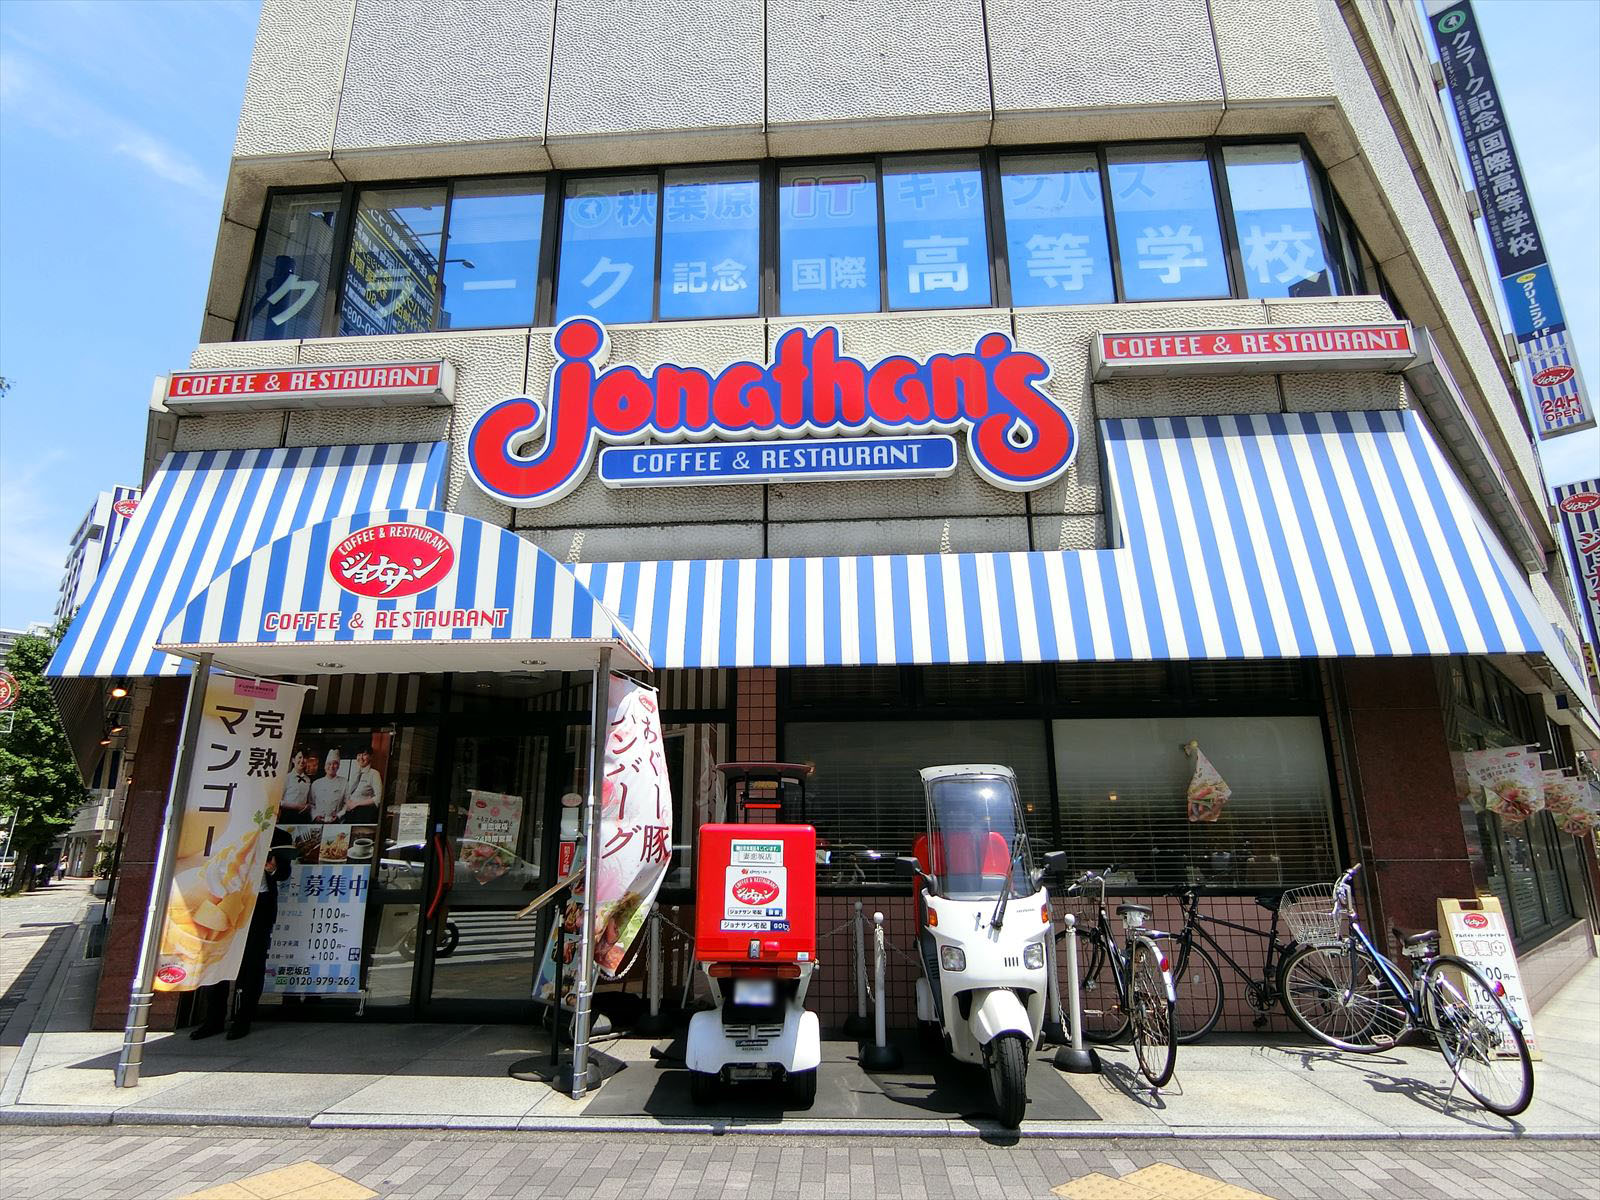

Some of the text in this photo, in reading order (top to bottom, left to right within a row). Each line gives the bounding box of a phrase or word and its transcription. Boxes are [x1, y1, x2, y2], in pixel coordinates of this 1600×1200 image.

[1451, 29, 1539, 258] クラーク記念国際高等学校
[265, 224, 1321, 326] クラーク記念国際高等学校
[1112, 330, 1401, 358] COFFEE & RESTAURANT
[1532, 327, 1550, 339] 1F
[177, 365, 437, 395] COFFEE & RESTAURANT
[1541, 393, 1580, 414] 24H
[1545, 406, 1582, 422] OPEN
[632, 443, 922, 475] COFFEE & RESTAURANT
[338, 525, 450, 556] COFFEE & RESTAURANT
[340, 552, 442, 596] ジョナサン
[265, 609, 508, 631] COFFEE & RESTAURANT
[246, 709, 286, 779] 完熟
[198, 704, 249, 858] マンゴー
[601, 714, 642, 861] ハンバーグ
[304, 874, 368, 897] 募集中
[278, 966, 311, 976] 妻恋坂店
[289, 976, 356, 986] 0120-979-262
